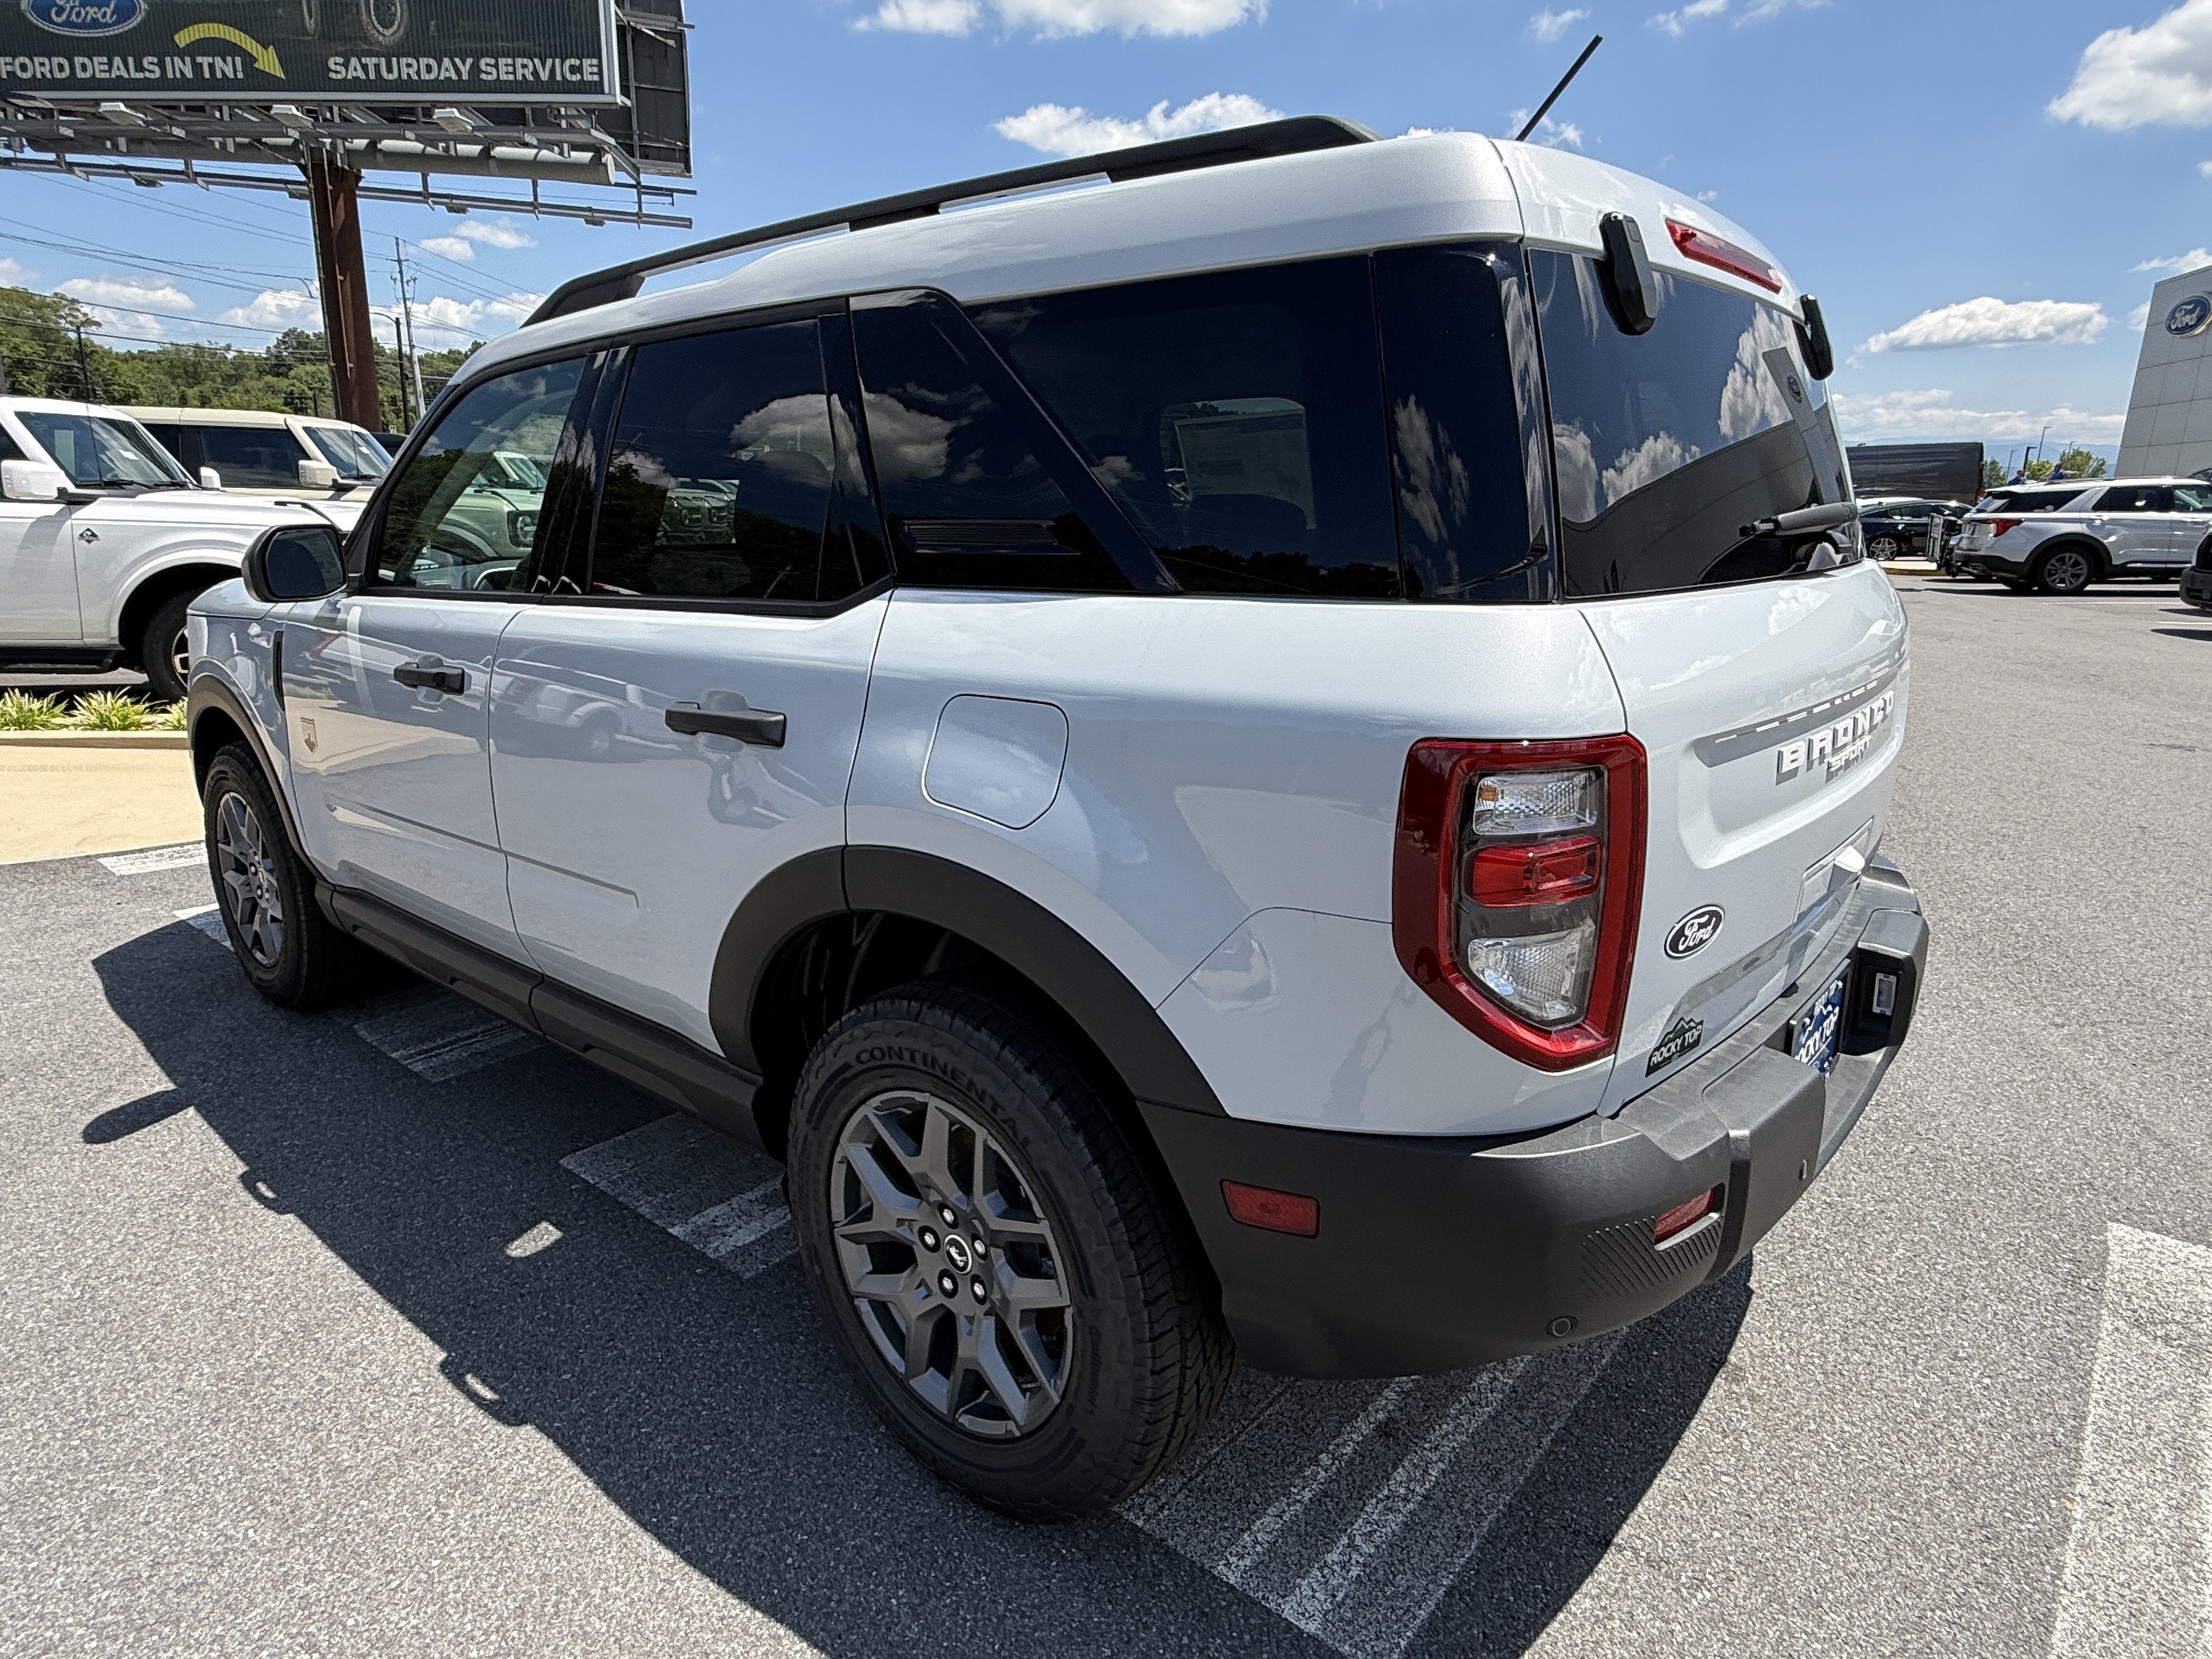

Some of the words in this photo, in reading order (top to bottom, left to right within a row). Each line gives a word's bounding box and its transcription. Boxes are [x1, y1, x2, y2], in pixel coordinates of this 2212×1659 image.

[51, 0, 117, 23] Ford
[0, 57, 69, 78] FORD
[76, 56, 161, 79] DEALS
[167, 57, 193, 79] IN
[196, 57, 244, 80] TN!
[328, 56, 473, 81] SATURDAY
[479, 58, 600, 81] SERVICE
[2171, 304, 2200, 330] Ford
[1778, 690, 1894, 774] BRONCO
[1824, 735, 1872, 771] SPORT
[1677, 915, 1716, 951] Ford
[1822, 1006, 1839, 1042] TOP
[1650, 1036, 1683, 1066] ROCKY
[1684, 1025, 1702, 1047] TOP
[856, 1045, 1032, 1160] CONTINENTAL
